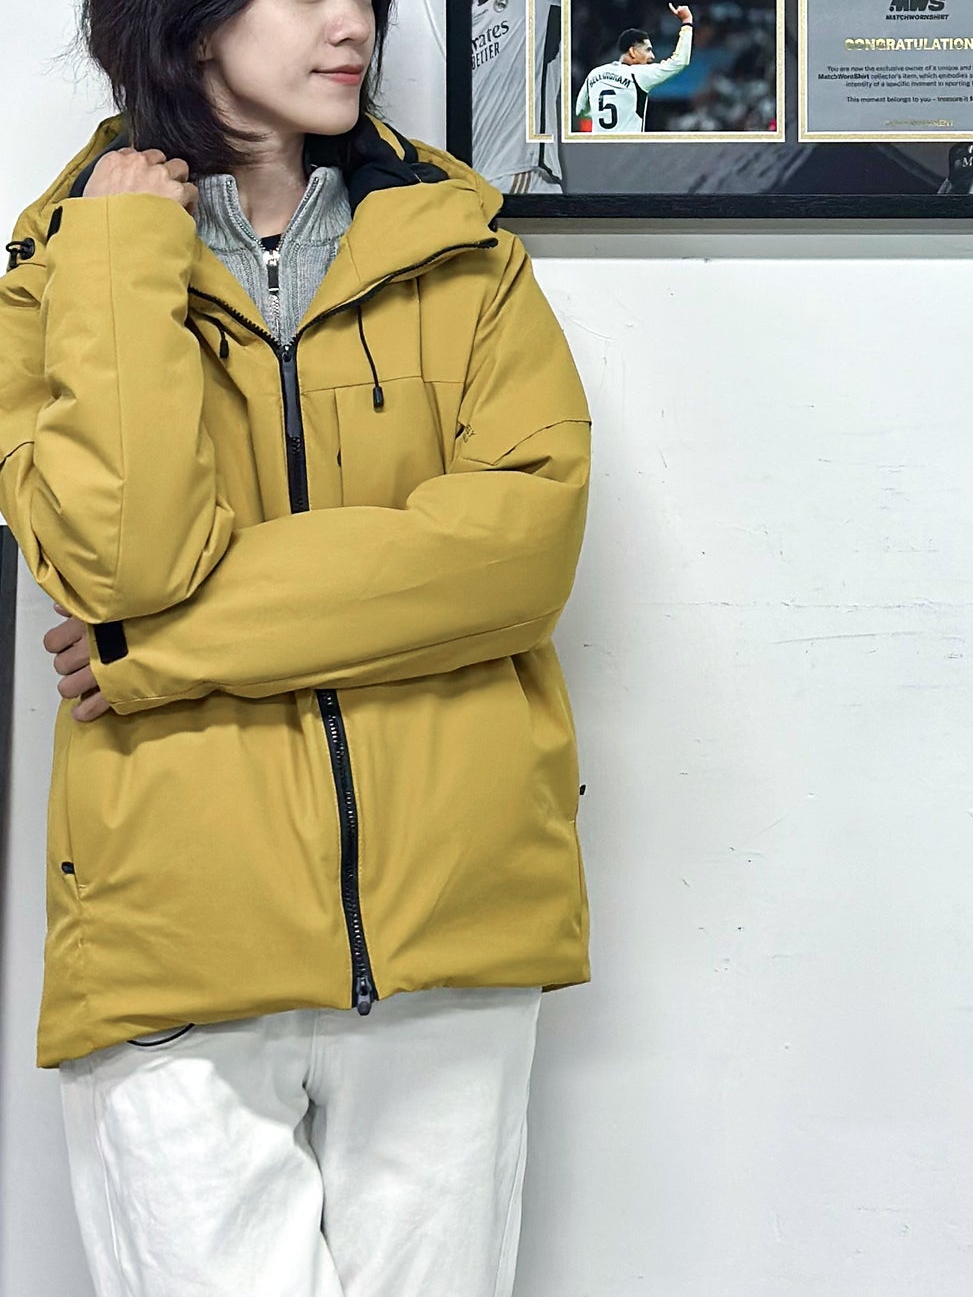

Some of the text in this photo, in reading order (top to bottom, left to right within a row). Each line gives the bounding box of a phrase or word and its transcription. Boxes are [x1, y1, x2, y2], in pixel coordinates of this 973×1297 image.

[902, 72, 919, 80] item,
[944, 80, 970, 88] sporting
[886, 96, 911, 104] belongs
[598, 88, 618, 130] 5
